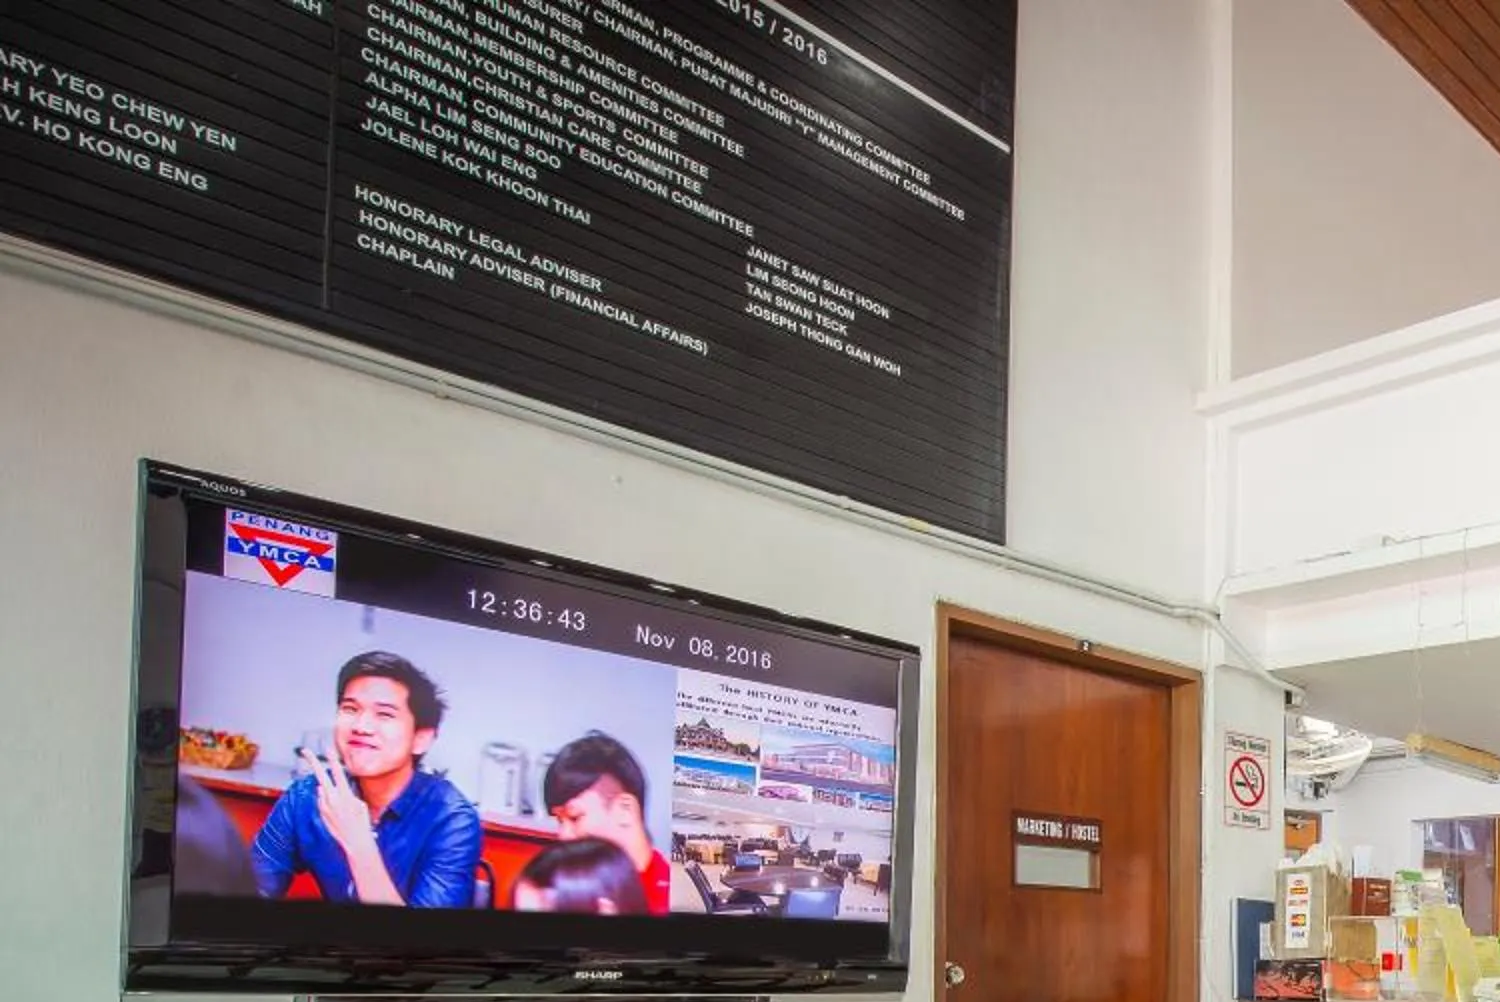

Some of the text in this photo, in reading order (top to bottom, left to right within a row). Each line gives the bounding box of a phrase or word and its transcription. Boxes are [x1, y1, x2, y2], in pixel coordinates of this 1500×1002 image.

[475, 10, 556, 61] BUILDING
[560, 56, 572, 69] &
[577, 63, 659, 114] AMENITIES
[663, 107, 745, 158] COMMITTEE
[550, 28, 637, 84] RESOURCE
[641, 75, 725, 128] COMMITTEE
[782, 27, 828, 65] 2016
[29, 86, 101, 125] KENG
[109, 116, 178, 154] LOON
[52, 68, 105, 100] YEO
[112, 93, 185, 131] CHEW
[190, 121, 238, 151] YEN
[361, 47, 754, 237] CHAIRMAN, COMMUNITY EDUCATION COMMITTEE
[365, 71, 562, 169] ALPHA LIM SENG SOO
[366, 97, 537, 181] JAEL LOH WAI ENG
[536, 84, 547, 100] &
[552, 92, 616, 133] SPORTS
[623, 128, 709, 179] COMMITTEE
[589, 90, 680, 144] COMMITTEE
[593, 10, 677, 67] CHAIRMAN,
[681, 57, 727, 91] PUSAT
[729, 83, 792, 127] MAJUDIRI
[818, 132, 901, 186] MANAGEMENT
[903, 178, 965, 221] COMMITTEE
[663, 26, 754, 86] PROGRAMME
[771, 87, 863, 147] COORDINATING
[865, 141, 931, 185] COMMITTEE
[0, 104, 210, 191] V. HO KONG ENG
[361, 118, 592, 225] JOLENE KOK KHOON THAI
[567, 121, 612, 151] CARE
[615, 144, 703, 195] COMMITTEE
[355, 184, 603, 292] HONORARY LEGAL ADVISER
[357, 233, 456, 281] CHAPLAIN
[359, 210, 709, 356] HONORARY ADVISER (FINANCIAL AFFAIRS)
[745, 281, 848, 336] TAN SWAN TECK
[746, 263, 855, 321] LIM SEONG HOON
[747, 246, 890, 319] JANET SAW SUAT HOON
[745, 302, 901, 377] JOSEPH THONG GAN WOH
[200, 479, 247, 497] AQUOS
[231, 511, 329, 541] PENANG
[240, 540, 321, 569] YMCA
[467, 589, 586, 632] 12:36:43
[635, 625, 675, 650] Nov
[726, 645, 771, 670] 2016
[747, 690, 800, 707] HISTORY
